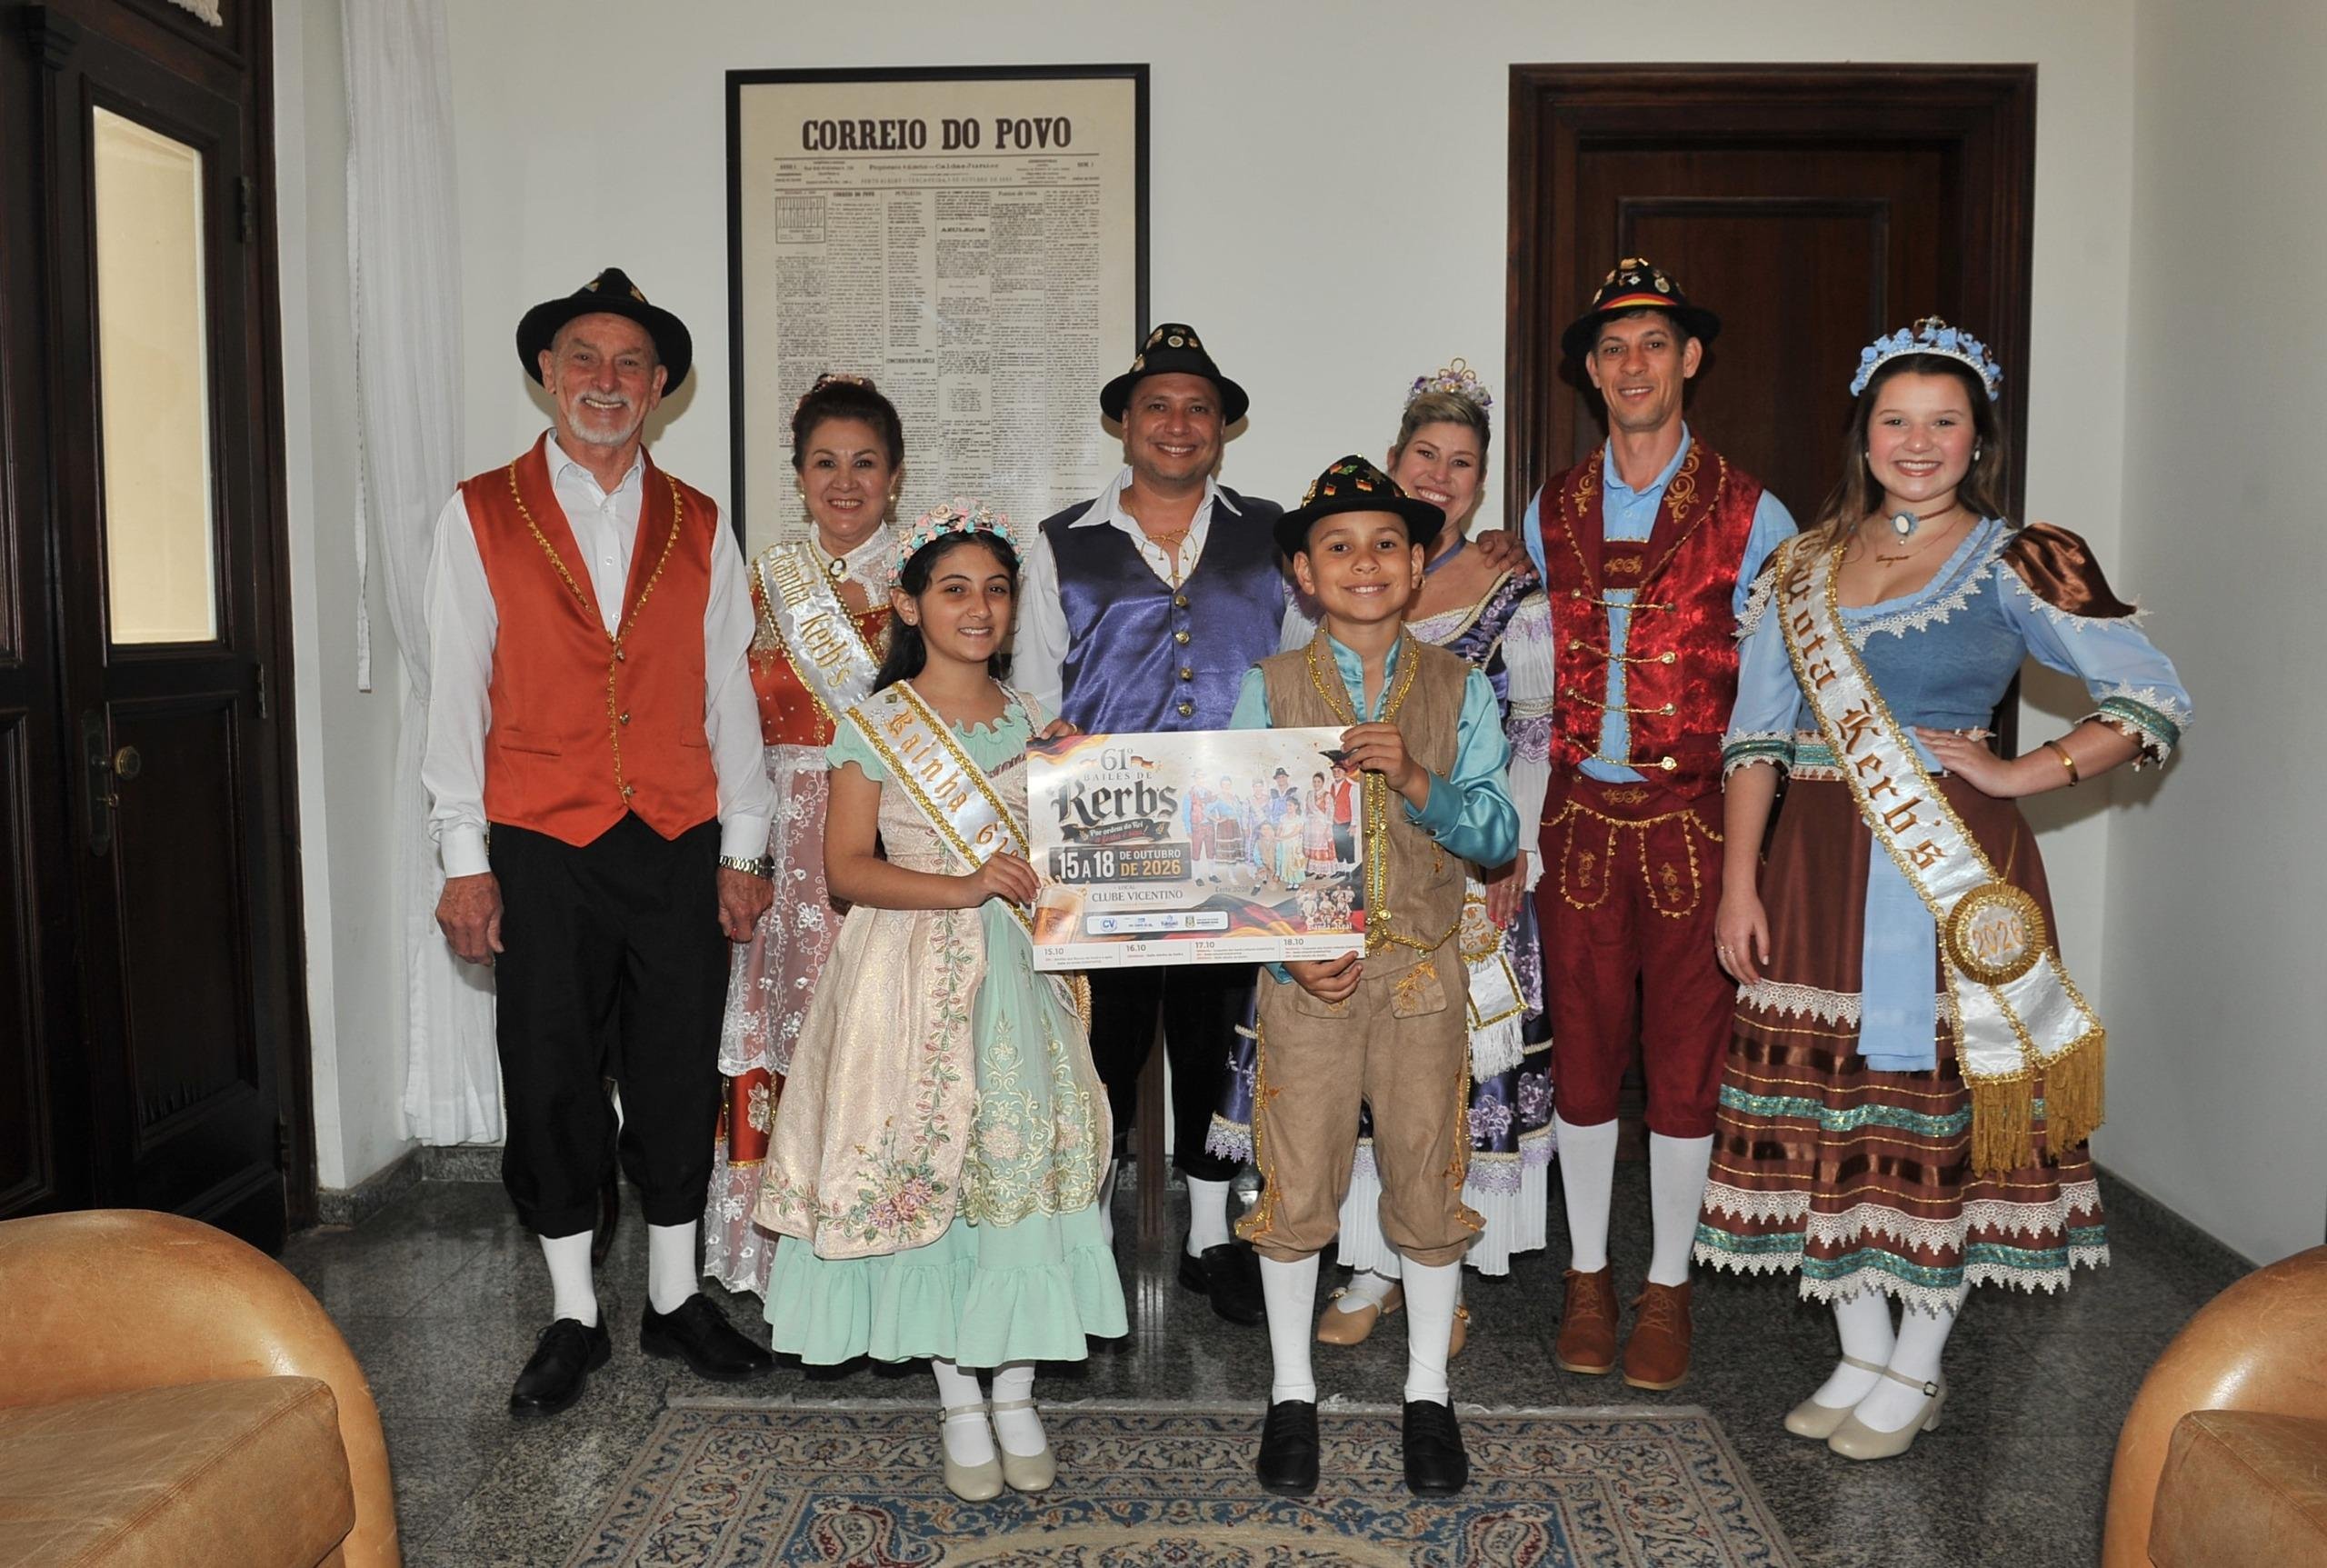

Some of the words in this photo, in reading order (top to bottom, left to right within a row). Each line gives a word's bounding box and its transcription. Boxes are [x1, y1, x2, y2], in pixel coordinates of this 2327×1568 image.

[803, 119, 927, 151] CORREIO
[942, 118, 981, 150] DO
[995, 116, 1072, 149] POVO
[885, 709, 969, 814] Rainha
[1084, 772, 1131, 782] BAILES
[1136, 771, 1153, 780] DE
[1119, 851, 1133, 860] DE
[1134, 849, 1181, 860] OUTUBRO
[1058, 851, 1080, 880] 15
[1082, 859, 1092, 878] A
[1093, 850, 1115, 878] 18
[1120, 863, 1139, 877] DE
[1142, 860, 1181, 876] 2026
[1092, 892, 1125, 903] CLUBE
[1128, 890, 1183, 902] VICENTINO
[1102, 919, 1115, 928] CV
[1972, 915, 2025, 962] 2026
[1044, 947, 1064, 955] 15.10
[1126, 944, 1146, 952] 16.10
[1195, 941, 1214, 949] 17.10
